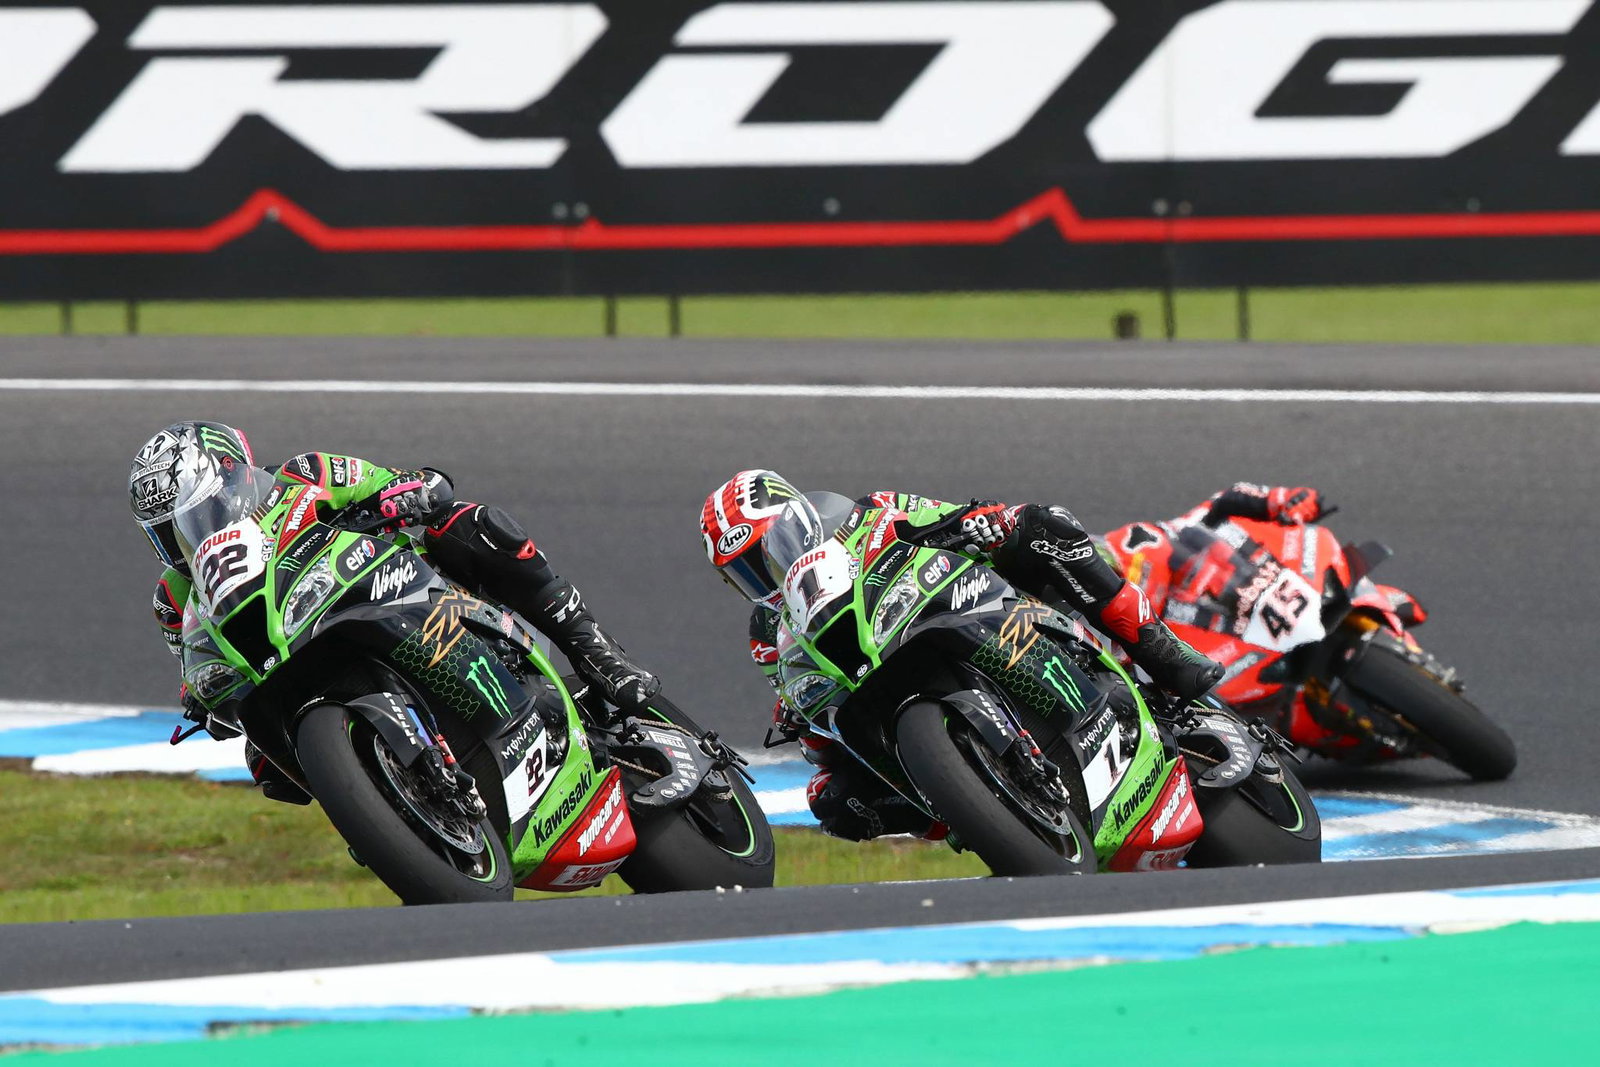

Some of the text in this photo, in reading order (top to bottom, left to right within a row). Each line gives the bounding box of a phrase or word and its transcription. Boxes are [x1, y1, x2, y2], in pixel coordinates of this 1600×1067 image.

[0, 0, 1600, 172] ROG
[137, 486, 180, 511] SHARK
[346, 549, 367, 571] elf
[721, 526, 747, 552] Arai
[202, 543, 249, 605] 22
[370, 555, 418, 601] Ninja
[924, 564, 942, 585] elf
[950, 569, 991, 611] Ninja
[383, 692, 417, 745] PIRELLI
[501, 712, 541, 760] MONSTER
[972, 689, 1008, 736] PIRELLI
[1078, 707, 1113, 751] MONSTER
[1103, 740, 1122, 787] 1
[533, 768, 593, 848] Kawasaki
[1113, 753, 1164, 830] Kawasaki
